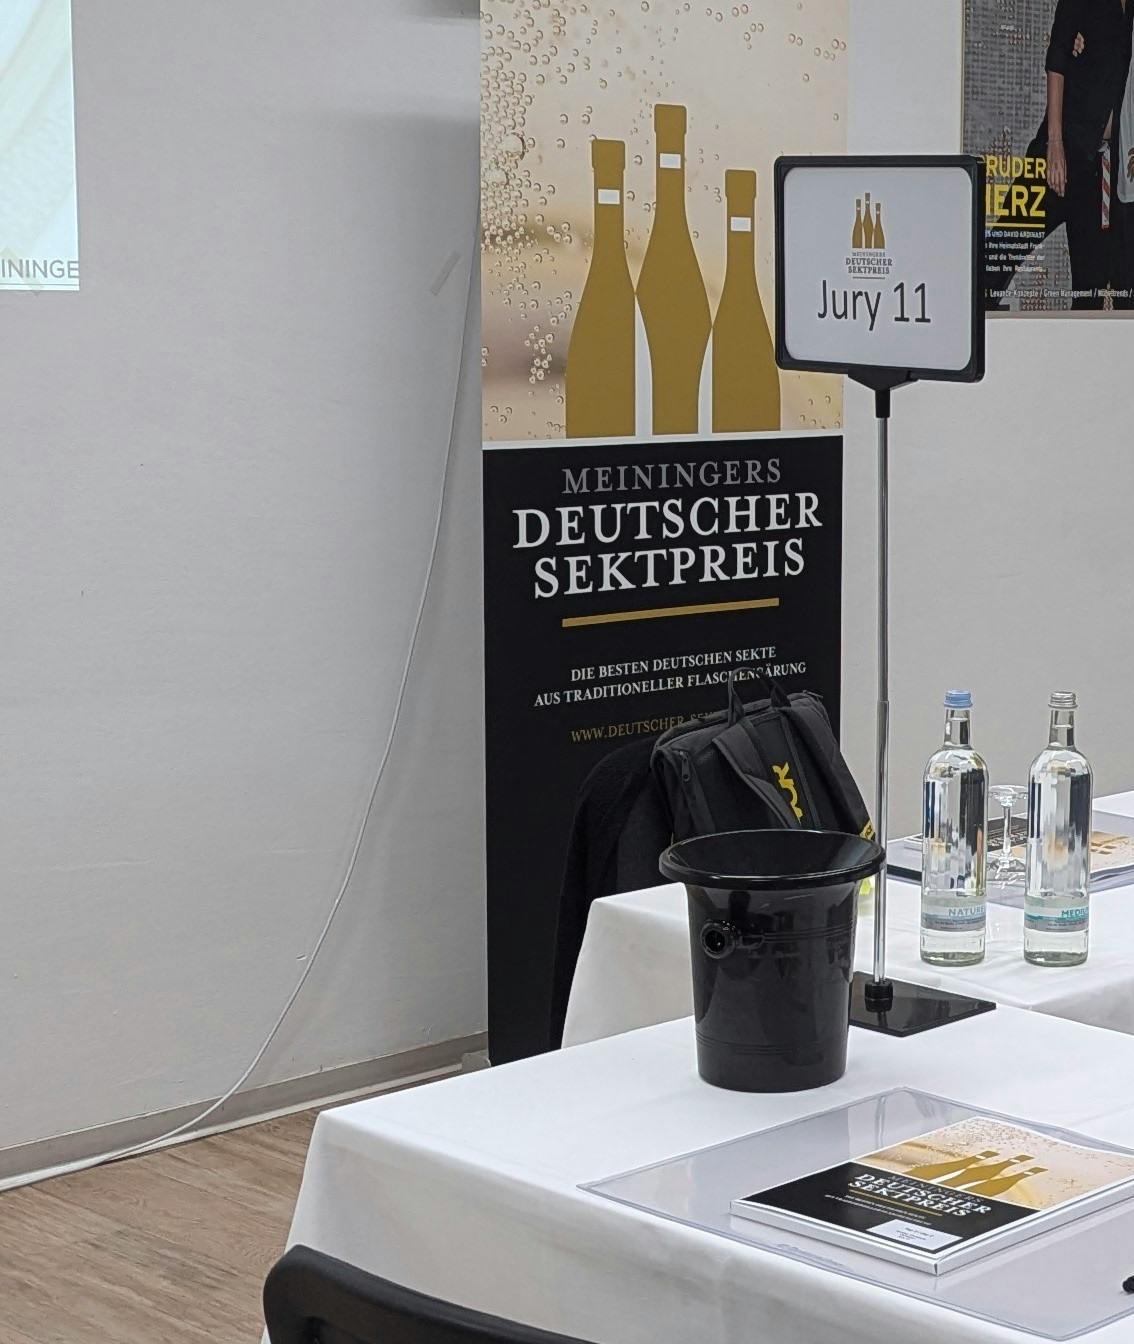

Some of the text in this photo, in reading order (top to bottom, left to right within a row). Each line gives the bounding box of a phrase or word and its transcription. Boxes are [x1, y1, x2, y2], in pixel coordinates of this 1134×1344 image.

[0, 259, 80, 279] ININGE
[845, 257, 893, 266] DEUTSCHER
[847, 266, 890, 274] SEKTPREIS
[817, 280, 931, 331] Jury 11
[562, 458, 782, 495] MEININGERS
[512, 492, 823, 549] DEUTSCHER
[534, 538, 806, 599] SEKTPREIS
[570, 646, 777, 682] DIE BESTEN DEUTSCHEN SEKTE
[534, 690, 561, 707] AUS
[563, 676, 685, 704] TRADITIONELLER
[948, 906, 986, 917] NATURE
[848, 1180, 973, 1217] SEKTPREIS
[854, 1173, 992, 1214] DEUTSCHER
